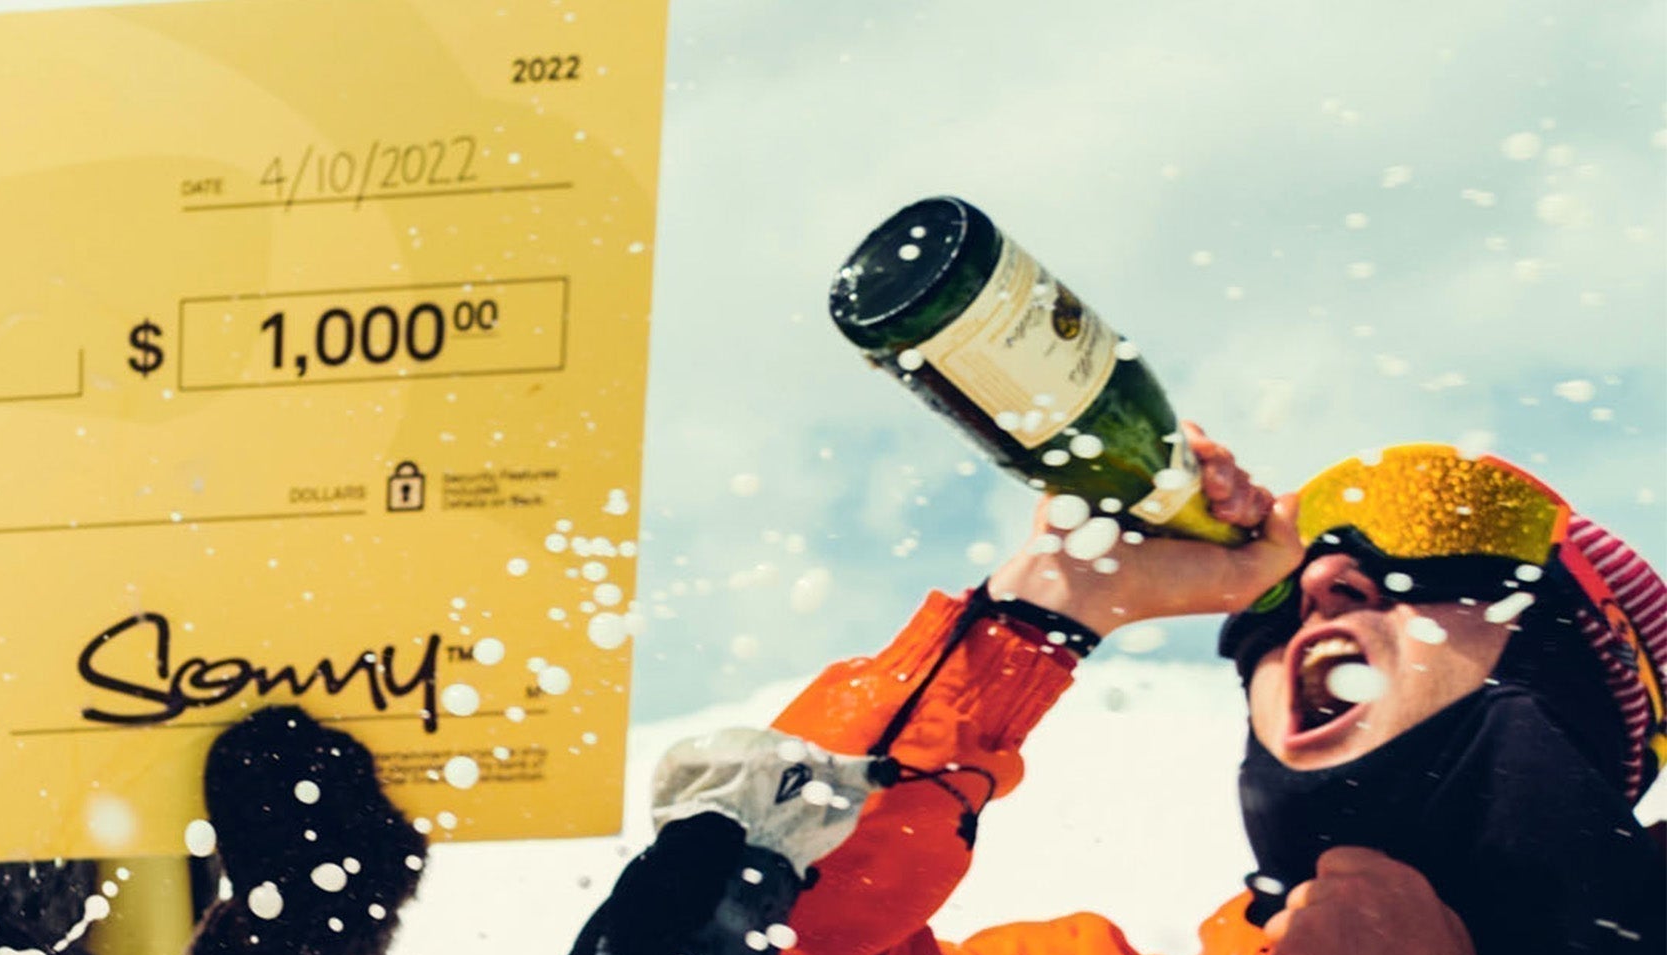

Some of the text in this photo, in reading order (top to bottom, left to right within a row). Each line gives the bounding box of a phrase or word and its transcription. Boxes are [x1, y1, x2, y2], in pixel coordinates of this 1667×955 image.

[511, 55, 582, 84] 2022
[180, 177, 224, 196] DATE
[259, 135, 478, 212] 4/10/2022
[127, 318, 165, 378] $
[289, 484, 365, 503] DOLLARS
[77, 612, 442, 734] Sonny
